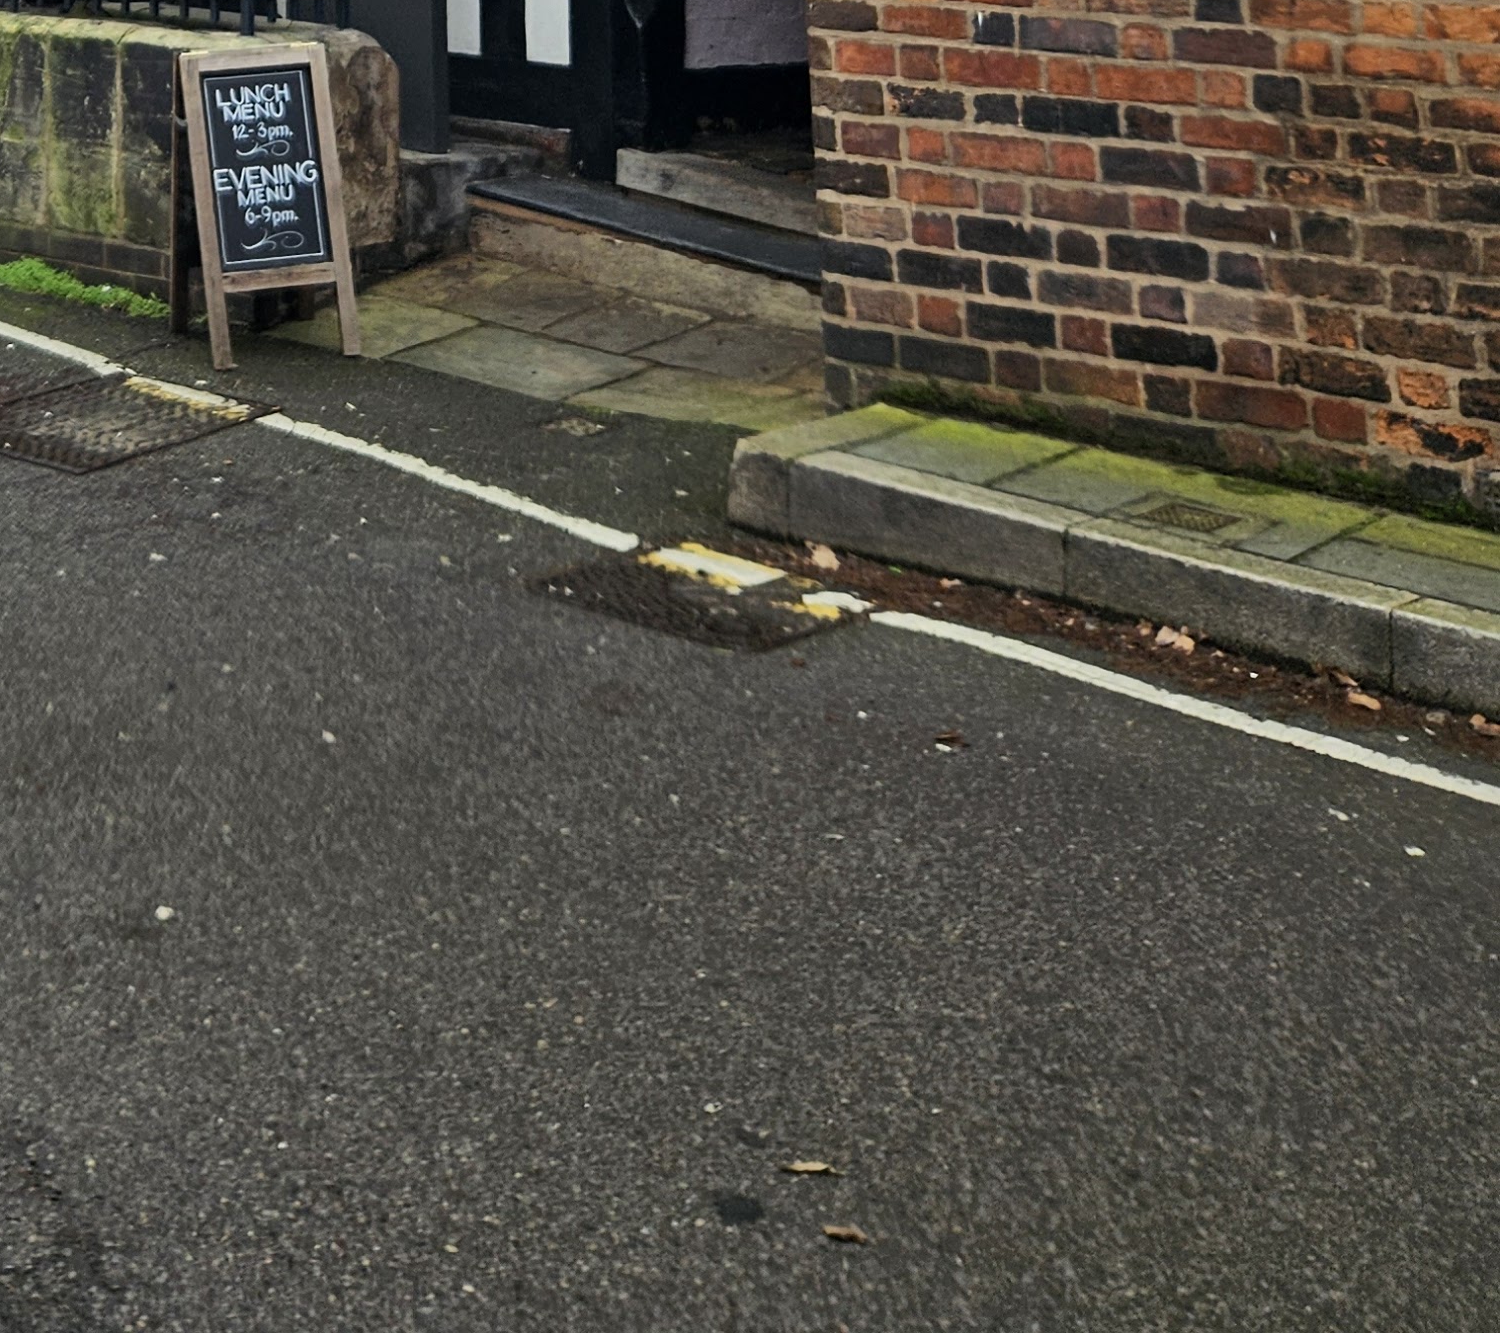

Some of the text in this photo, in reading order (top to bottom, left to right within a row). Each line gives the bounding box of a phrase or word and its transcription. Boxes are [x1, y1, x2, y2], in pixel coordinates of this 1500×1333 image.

[215, 83, 291, 107] LUNCH
[223, 101, 286, 122] MENU
[213, 160, 318, 192] EVENING
[237, 185, 293, 207] MENU
